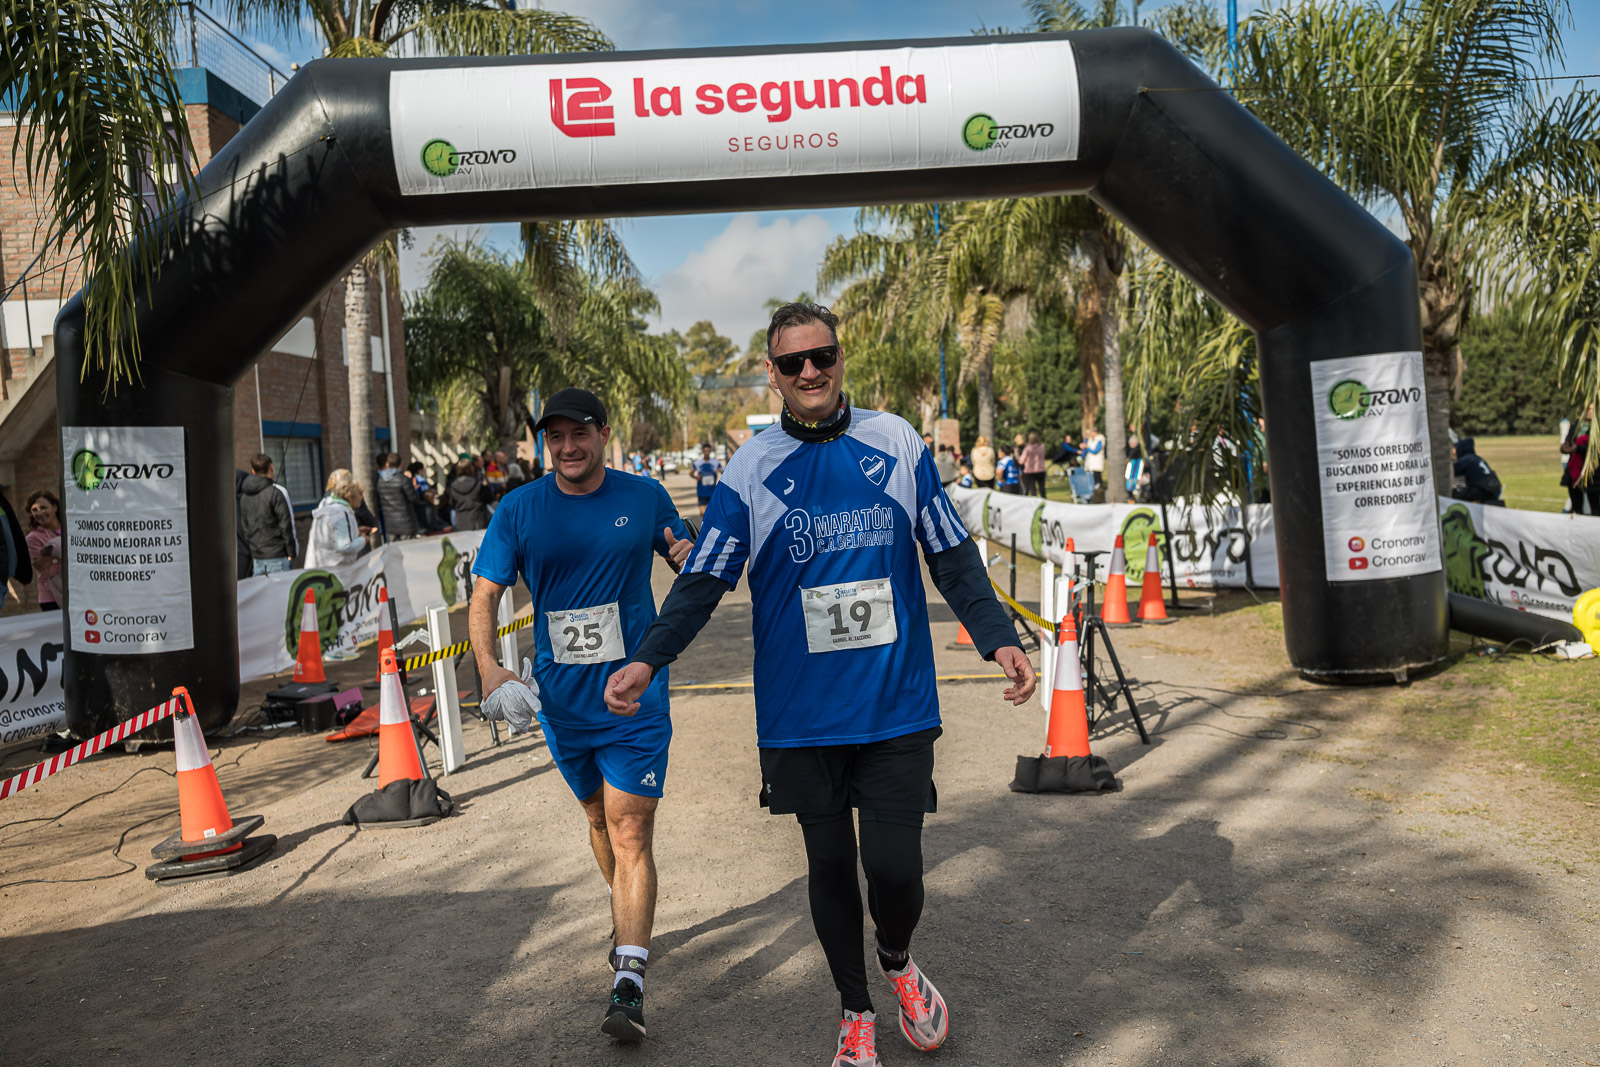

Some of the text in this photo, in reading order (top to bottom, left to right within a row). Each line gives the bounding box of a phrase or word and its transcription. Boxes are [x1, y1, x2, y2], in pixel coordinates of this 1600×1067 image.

[633, 66, 927, 123] la segunda
[728, 132, 839, 152] SEGUROS
[986, 141, 1009, 149] RAV
[448, 167, 472, 175] RAV
[1357, 408, 1384, 418] RAV
[1374, 441, 1423, 457] CORREDORES
[1325, 464, 1378, 477] BUSCANDO
[1381, 459, 1420, 473] MEJORAR
[93, 481, 118, 490] RAV
[1336, 474, 1425, 493] EXPERIENCIAS DE LOS
[106, 519, 173, 531] CORREDORES
[813, 503, 894, 539] MARATÓN
[70, 535, 182, 548] BUSCANDO MEJORAR LAS
[784, 508, 814, 563] 3
[1371, 533, 1426, 550] Cronorav
[76, 552, 173, 565] EXPERIENCIAS DE LOS
[1372, 551, 1427, 568] Cronorav
[103, 613, 167, 626] Cronorav
[827, 600, 871, 635] 19
[103, 630, 168, 643] Cronorav
[562, 622, 603, 651] 25
[4, 720, 60, 743] cronorav
